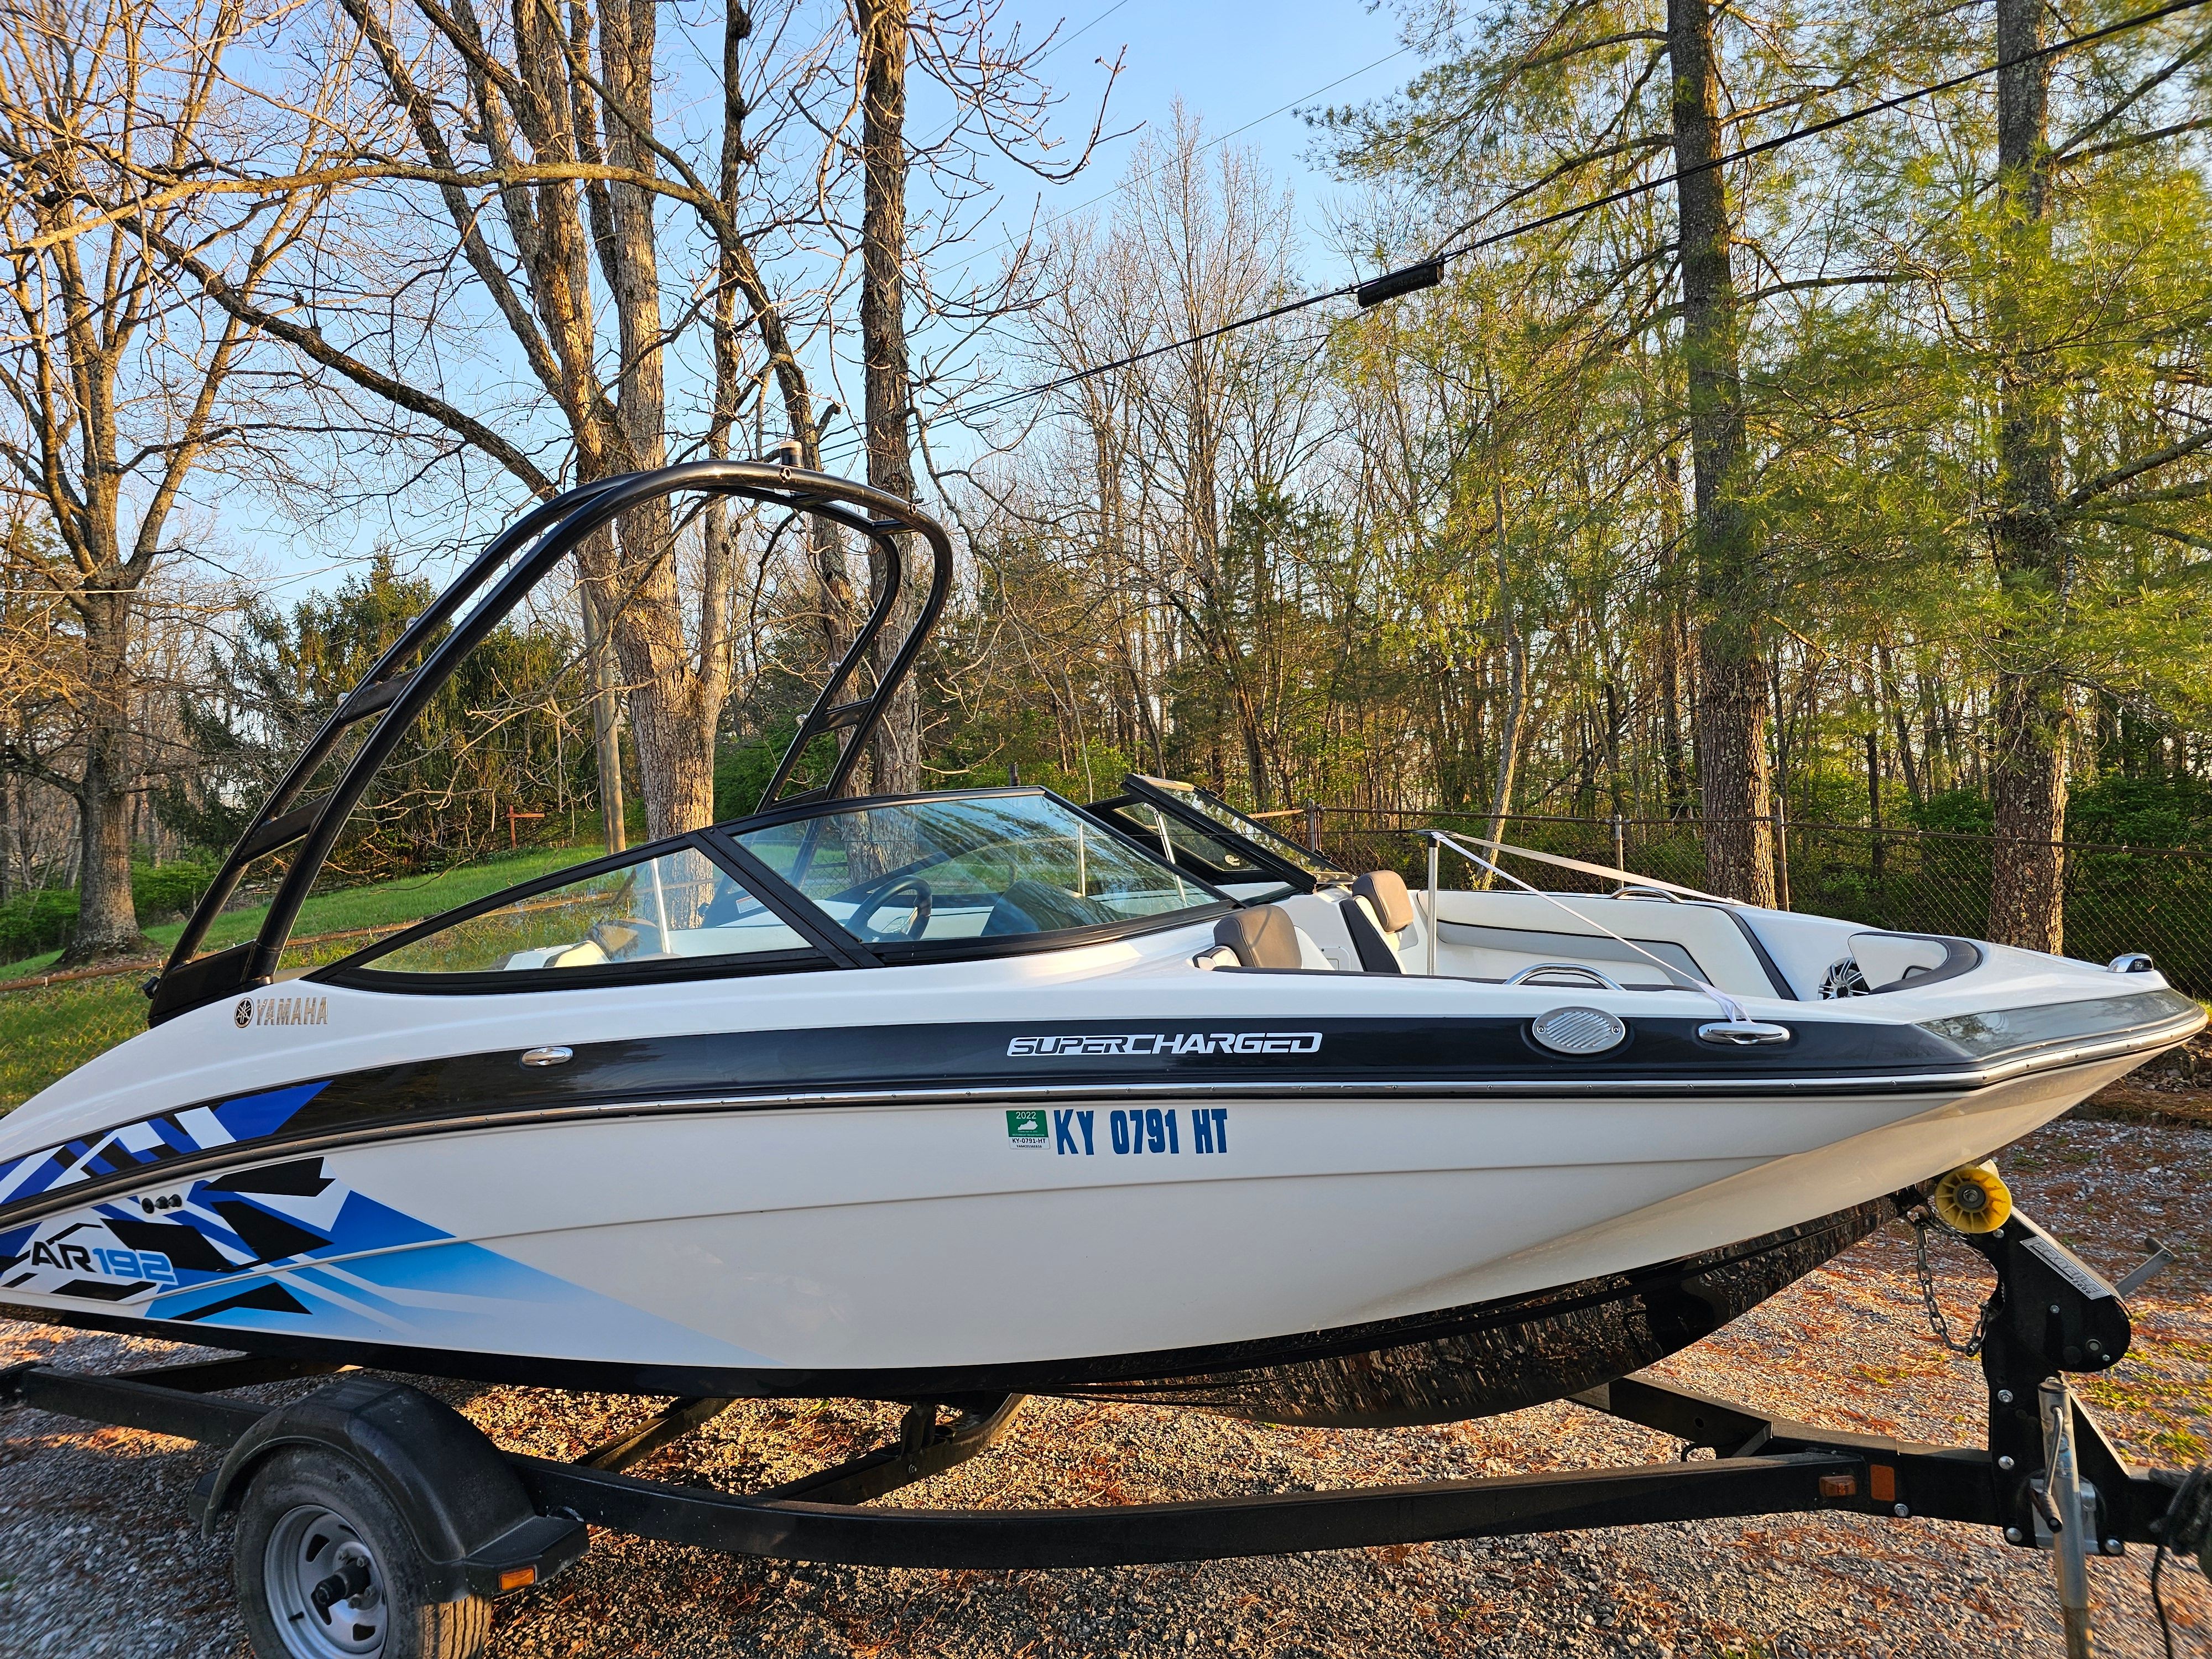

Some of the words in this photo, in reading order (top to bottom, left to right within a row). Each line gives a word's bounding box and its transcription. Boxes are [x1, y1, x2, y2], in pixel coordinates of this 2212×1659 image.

[257, 997, 328, 1025] YAMAHA
[1007, 1032, 1323, 1057] SUPERCHARGED
[1016, 1111, 1036, 1119] 2022
[1053, 1109, 1094, 1155] KY
[1110, 1108, 1180, 1155] 0791
[1192, 1108, 1228, 1154] HT
[31, 1241, 176, 1282] AR192
[2032, 1241, 2101, 1293] PROFILE
